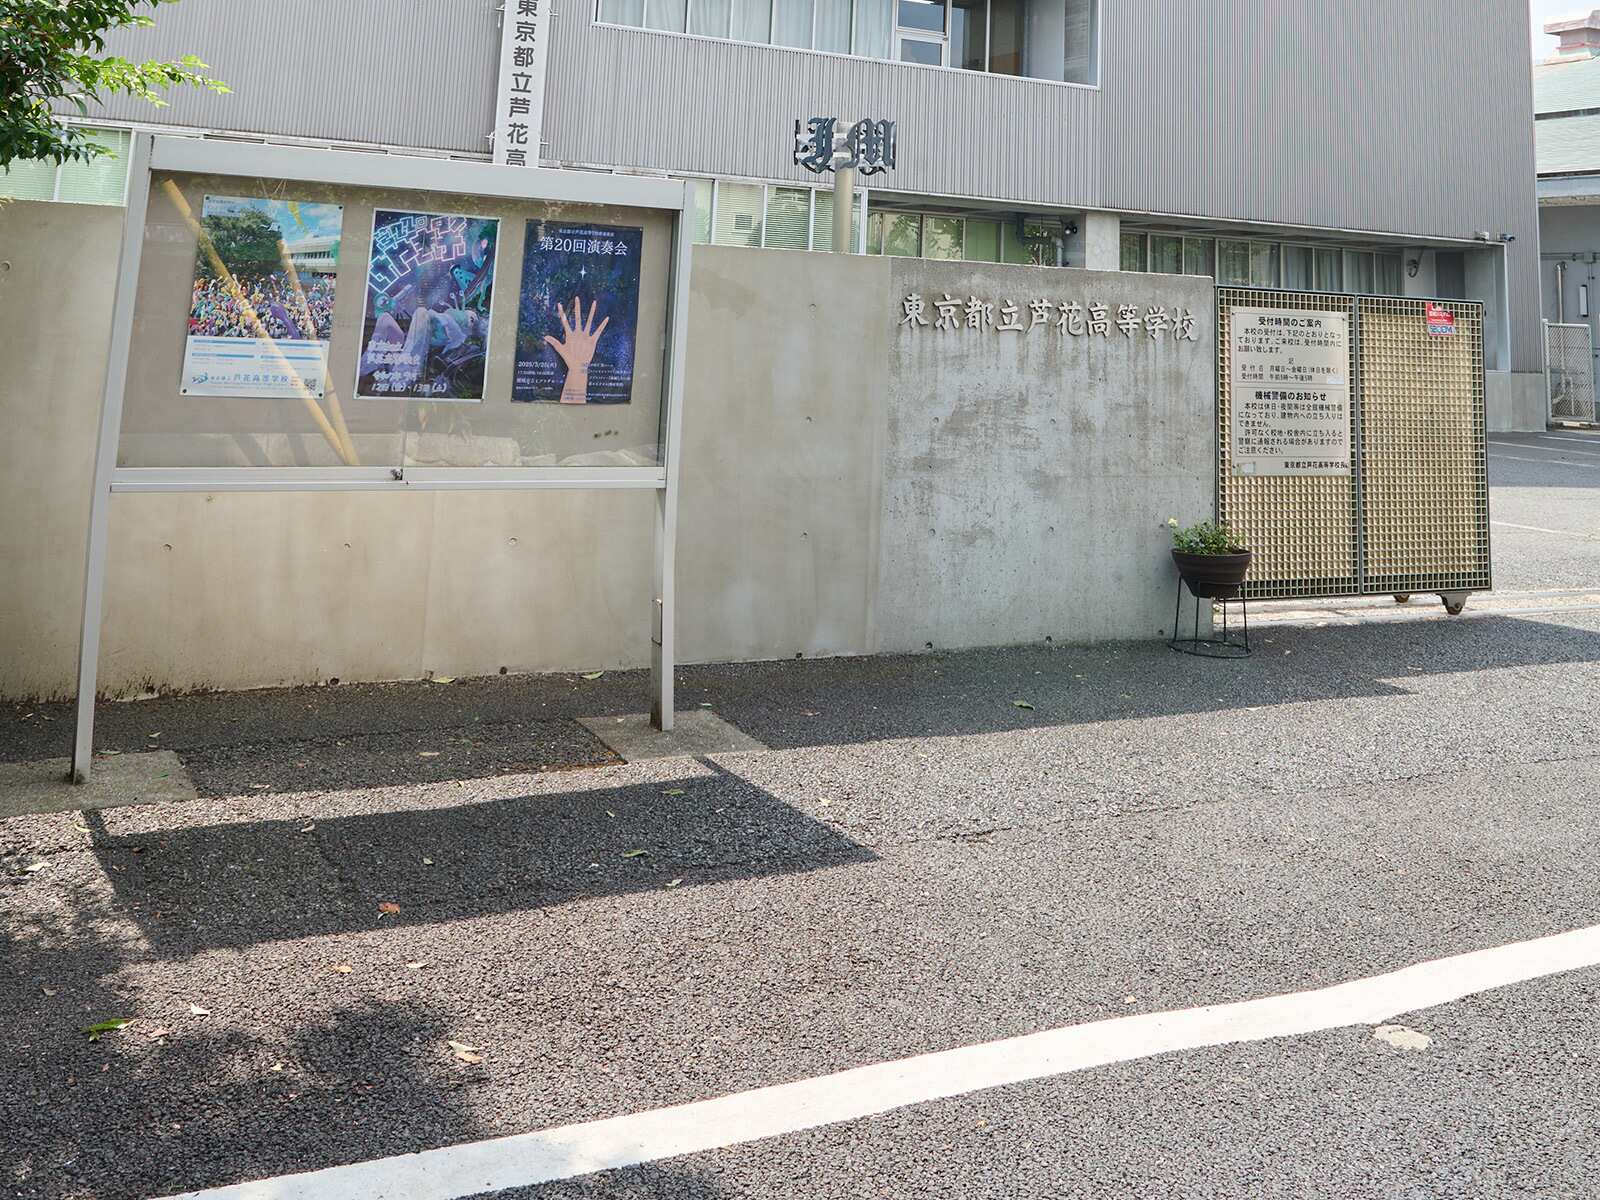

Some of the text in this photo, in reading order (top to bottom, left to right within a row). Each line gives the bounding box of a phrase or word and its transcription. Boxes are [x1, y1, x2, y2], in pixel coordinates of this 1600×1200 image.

[540, 236, 628, 256] 第20回演奏会
[899, 293, 1199, 341] 東京都立芦花高等学校
[1258, 316, 1322, 328] 受付時間のご案内
[1255, 391, 1327, 401] 機械警備のお知らせ
